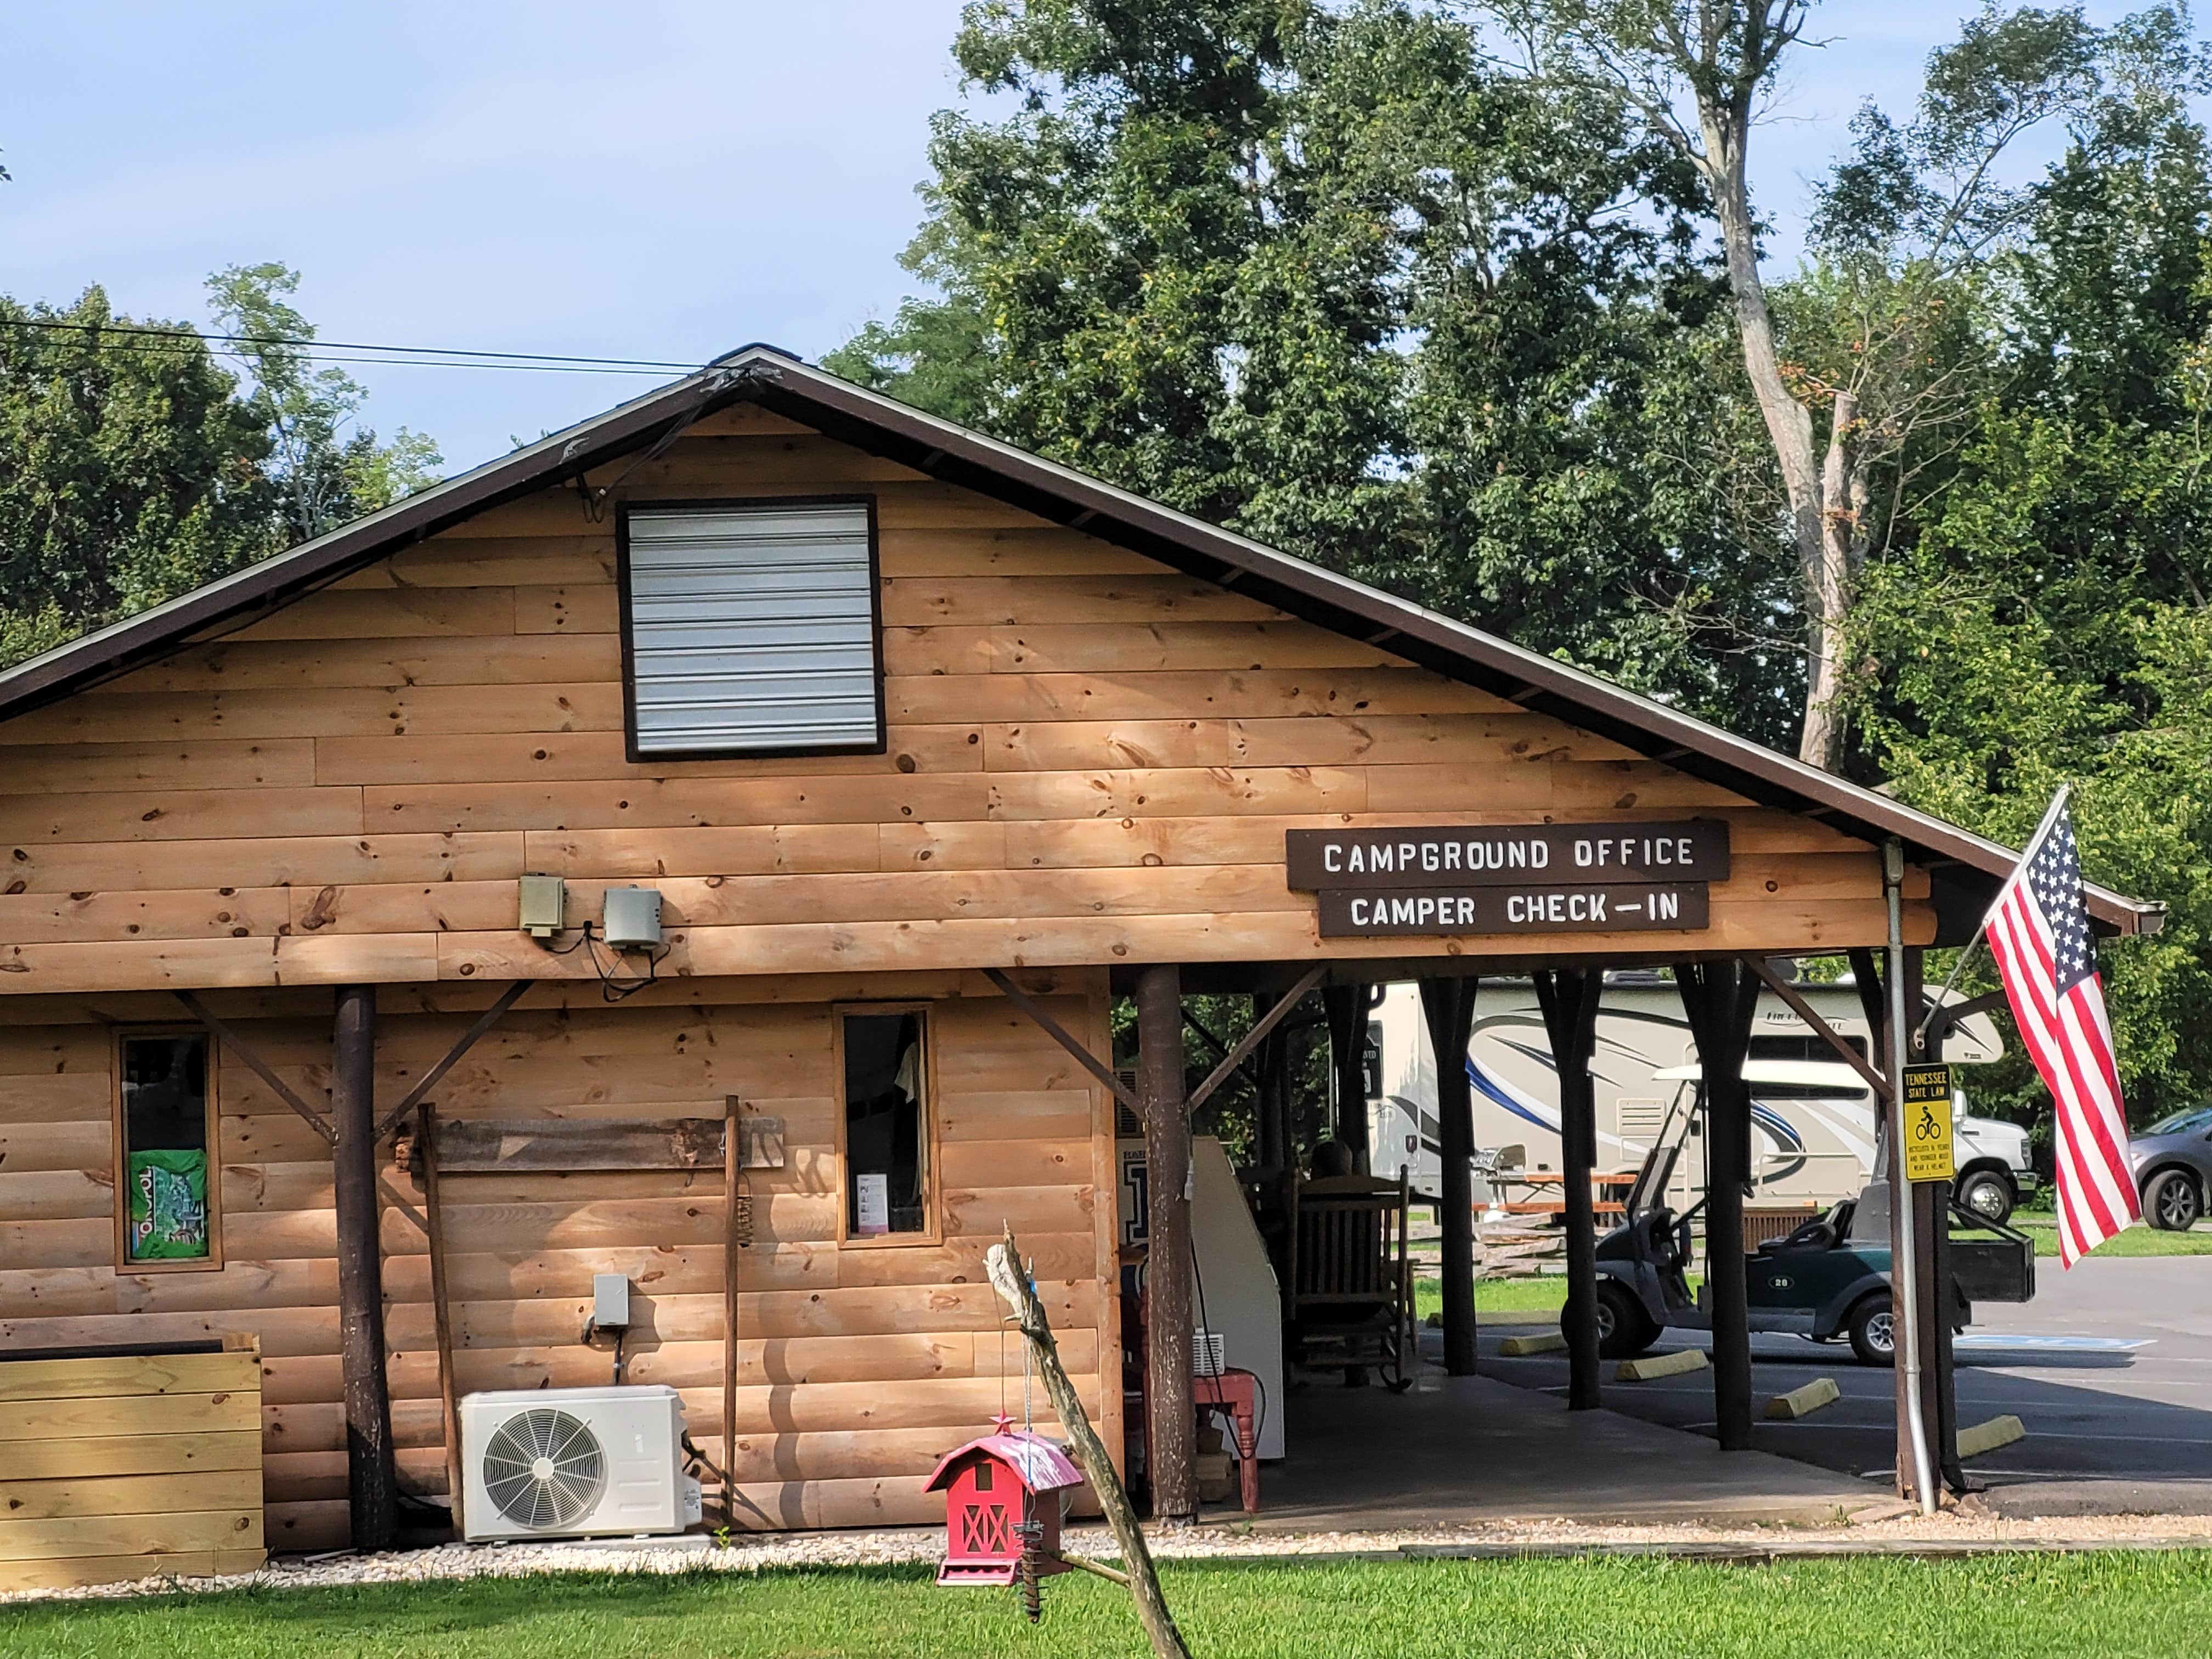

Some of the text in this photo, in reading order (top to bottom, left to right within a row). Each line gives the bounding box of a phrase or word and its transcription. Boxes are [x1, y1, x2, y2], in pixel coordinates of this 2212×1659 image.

[1324, 838, 1694, 873] CAMPGROUND OFFICE
[1350, 896, 1475, 926] CAMPER
[1905, 1071, 1947, 1086] TENNESSEE
[1909, 1086, 1945, 1098] STATE LAW
